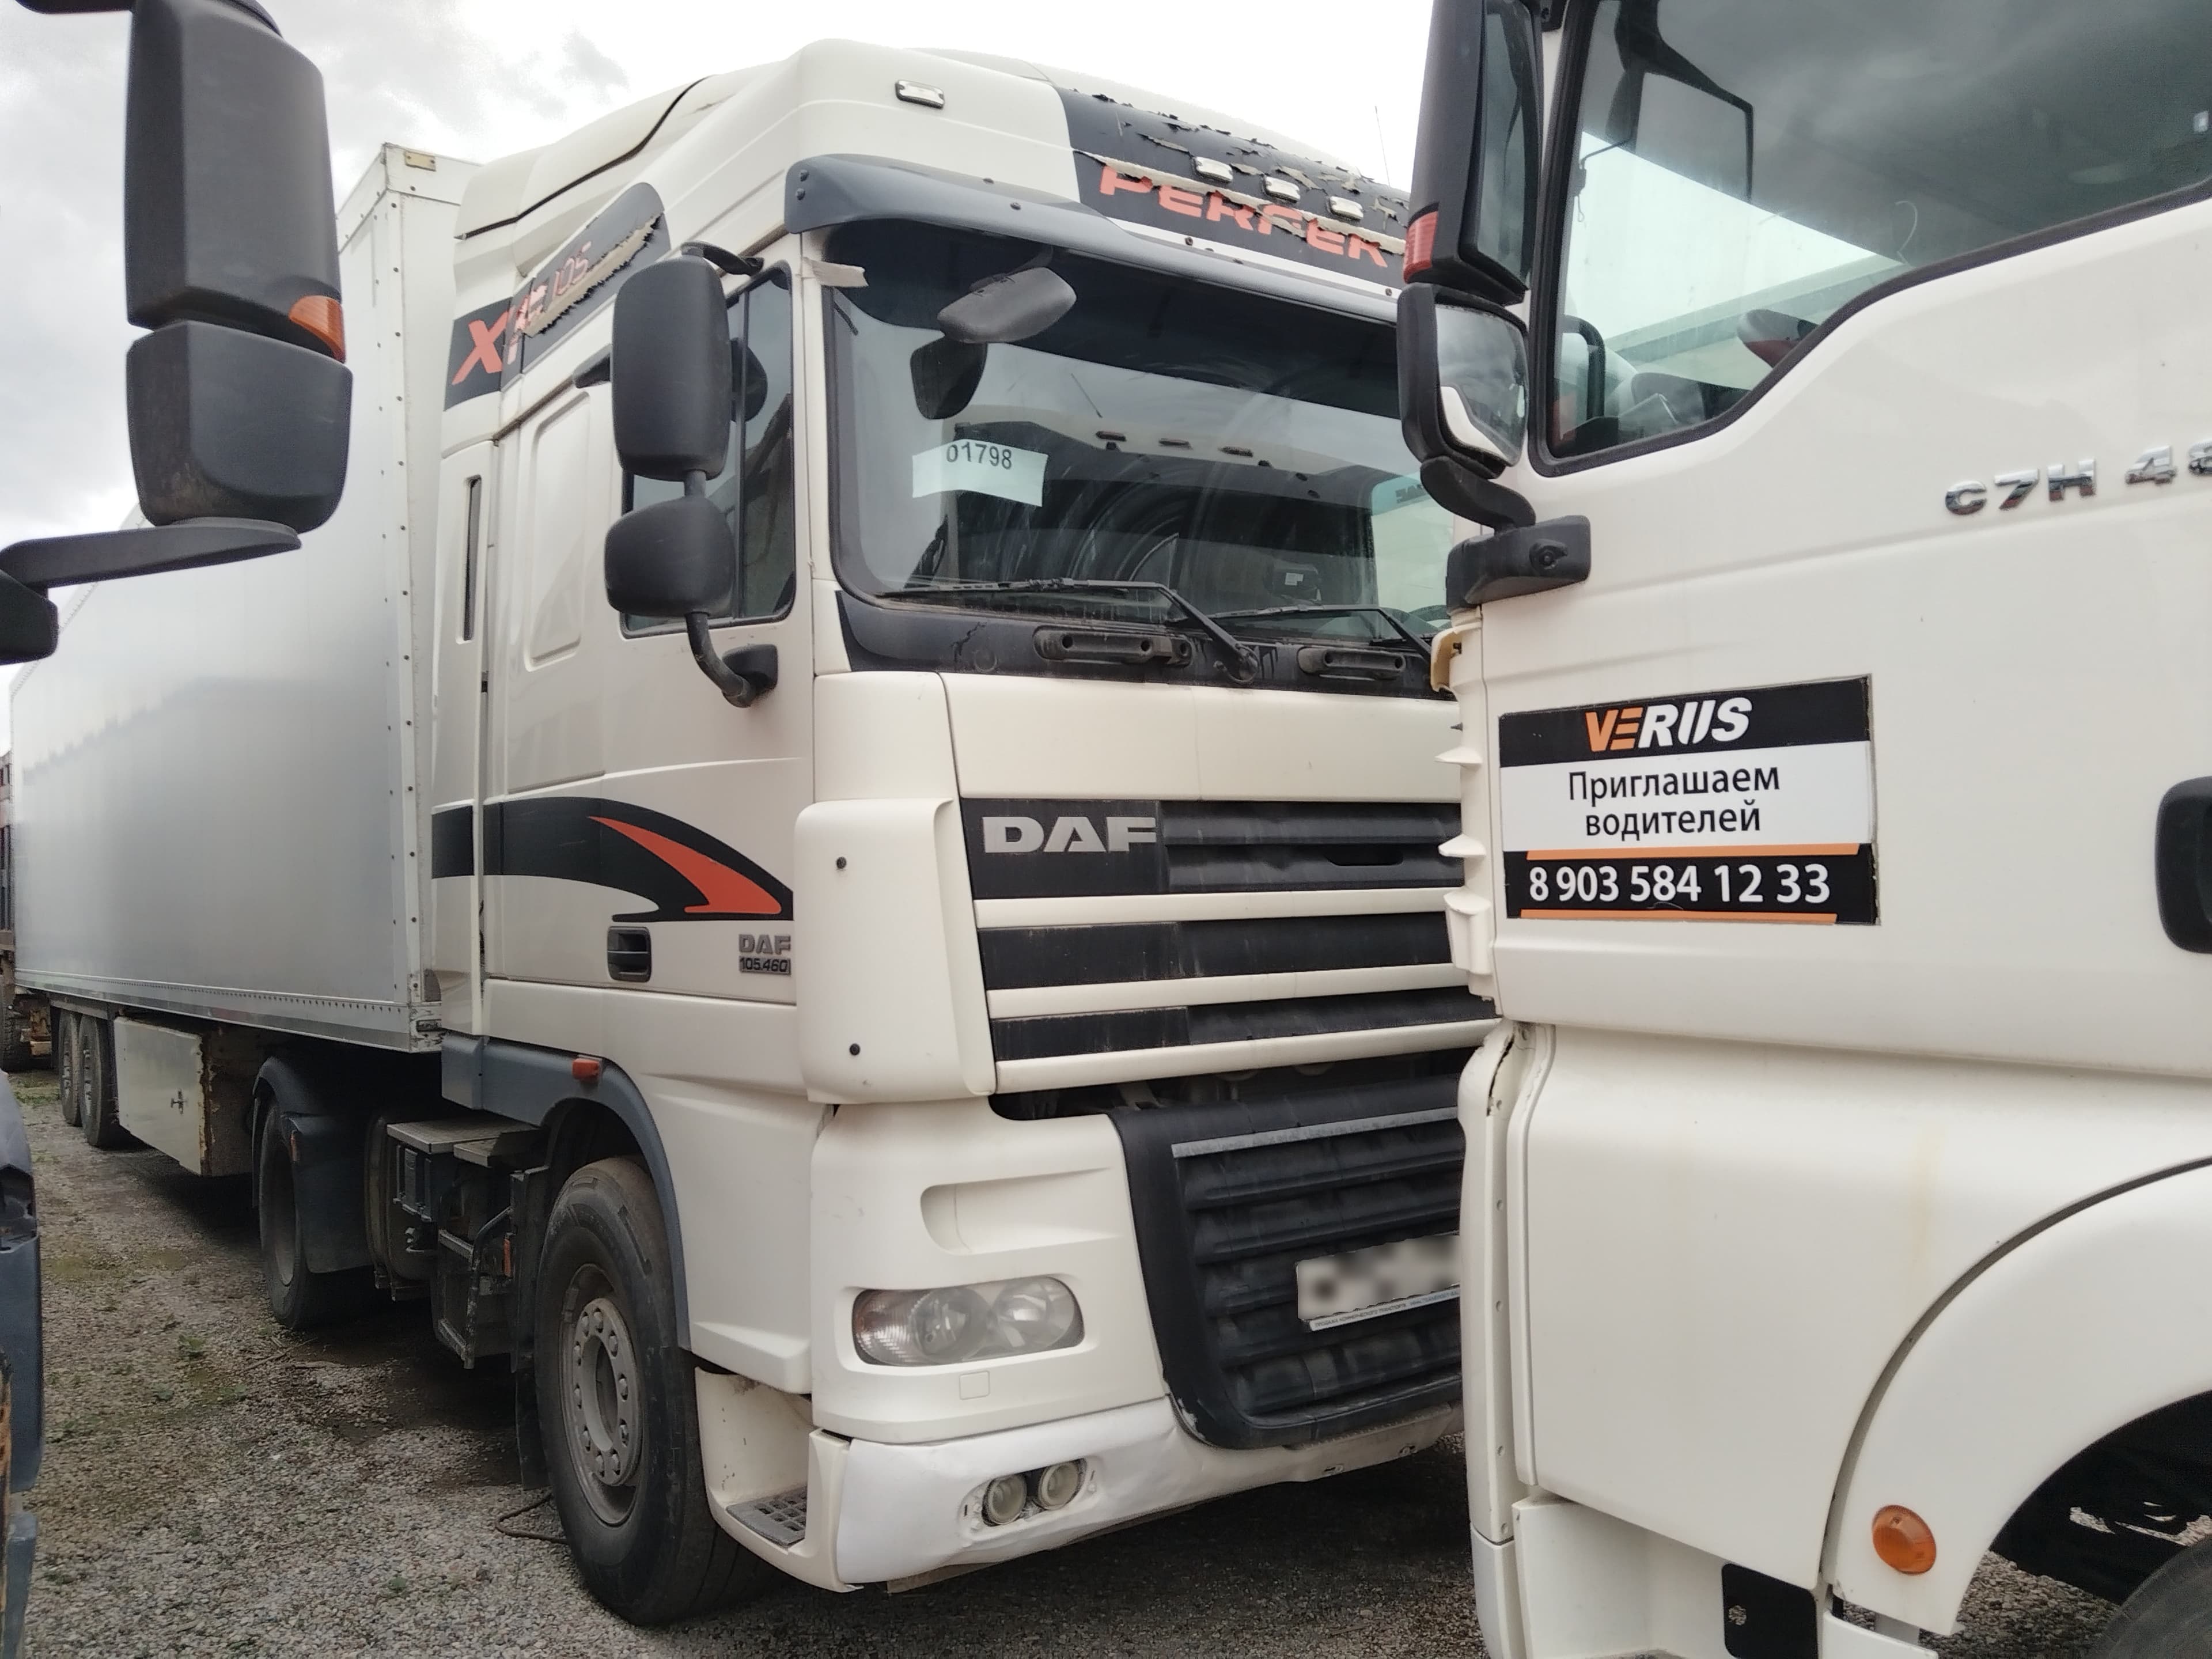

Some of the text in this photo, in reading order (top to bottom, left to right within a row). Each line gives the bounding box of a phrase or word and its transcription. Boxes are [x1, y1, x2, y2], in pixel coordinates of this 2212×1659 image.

[946, 441, 1013, 470] 01798
[1569, 766, 1780, 807] Приглашаем
[982, 816, 1157, 853] DAF
[1585, 799, 1761, 841] водителей
[1529, 863, 1830, 904] 8 903 584 12 33
[738, 933, 791, 955] DAF
[739, 956, 789, 973] 105.460
